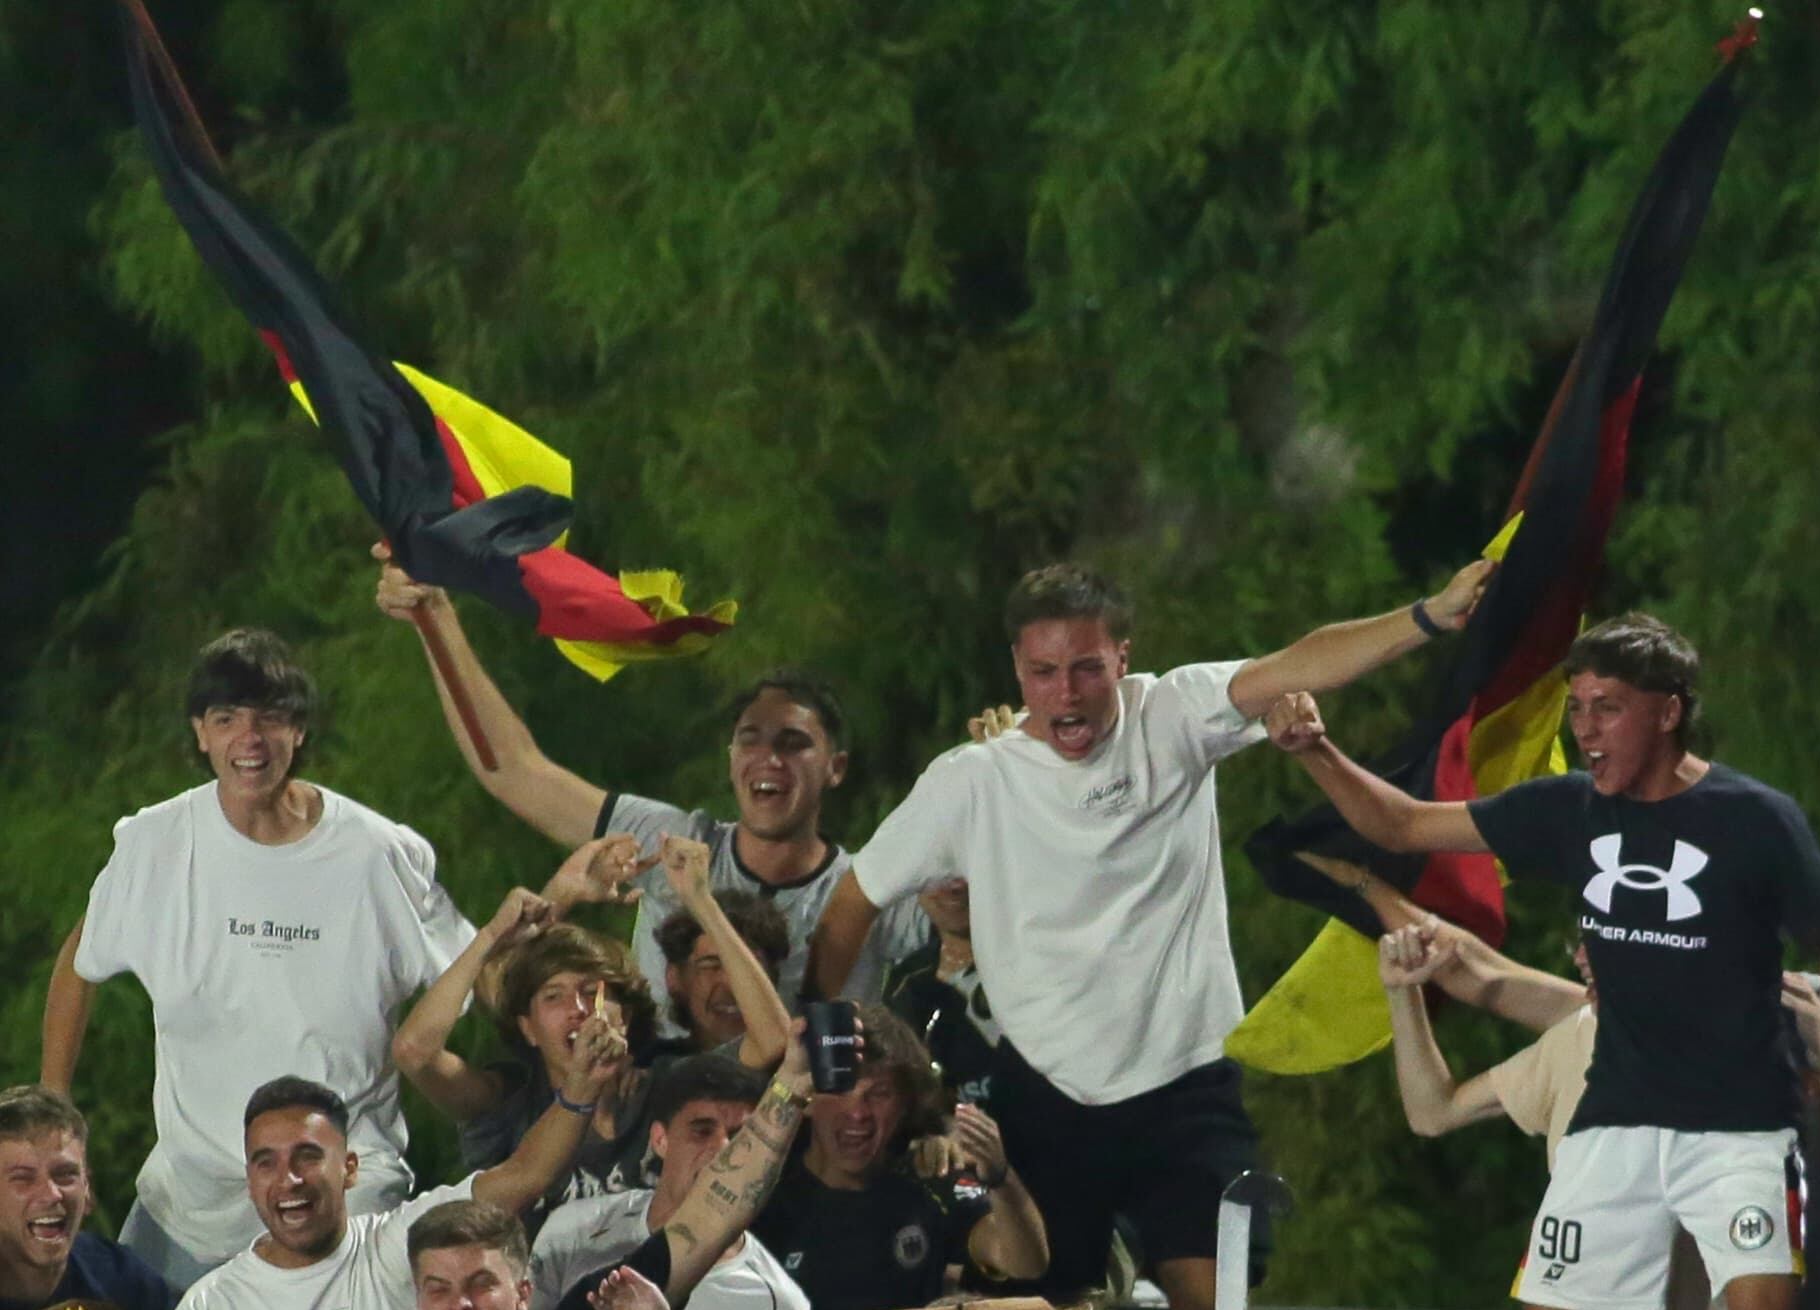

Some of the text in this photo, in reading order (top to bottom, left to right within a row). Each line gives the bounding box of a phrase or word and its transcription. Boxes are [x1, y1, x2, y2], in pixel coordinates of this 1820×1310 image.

[228, 918, 320, 941] Los Angeles
[1539, 1216, 1582, 1264] 90
